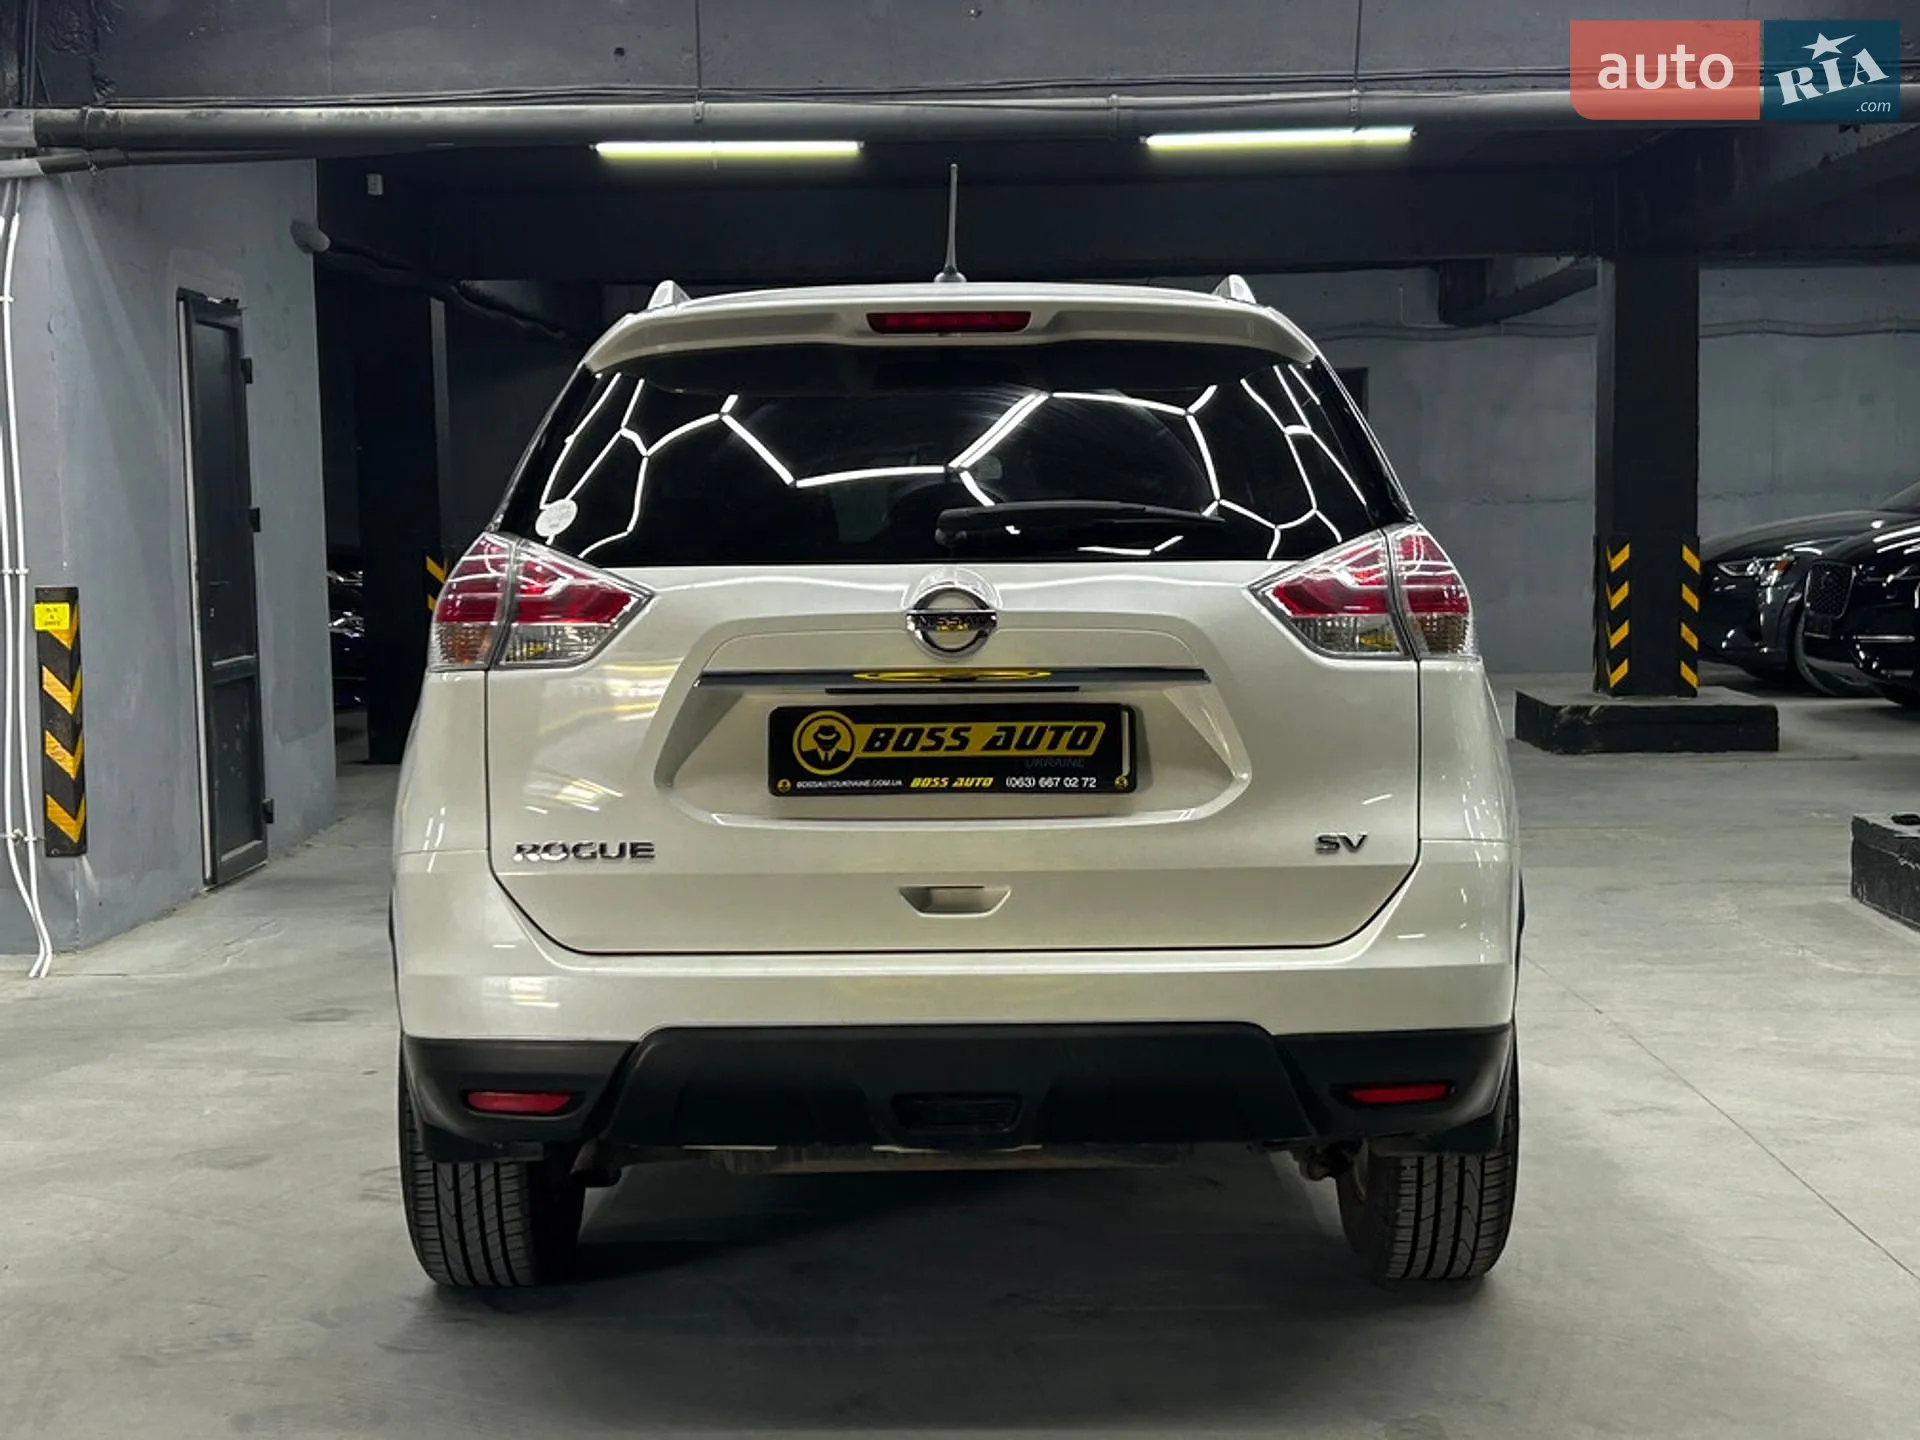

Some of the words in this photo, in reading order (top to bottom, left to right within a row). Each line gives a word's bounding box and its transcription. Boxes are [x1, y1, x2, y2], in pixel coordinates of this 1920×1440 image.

[862, 725, 972, 752] BOSS
[981, 724, 1100, 751] AUTO
[910, 777, 949, 788] BOSS
[952, 777, 994, 788] AUTO
[1006, 776, 1035, 788] (063)
[1063, 777, 1079, 788] 02
[1081, 777, 1097, 788] 72
[512, 840, 656, 862] ROGUE
[1315, 832, 1368, 854] SV
